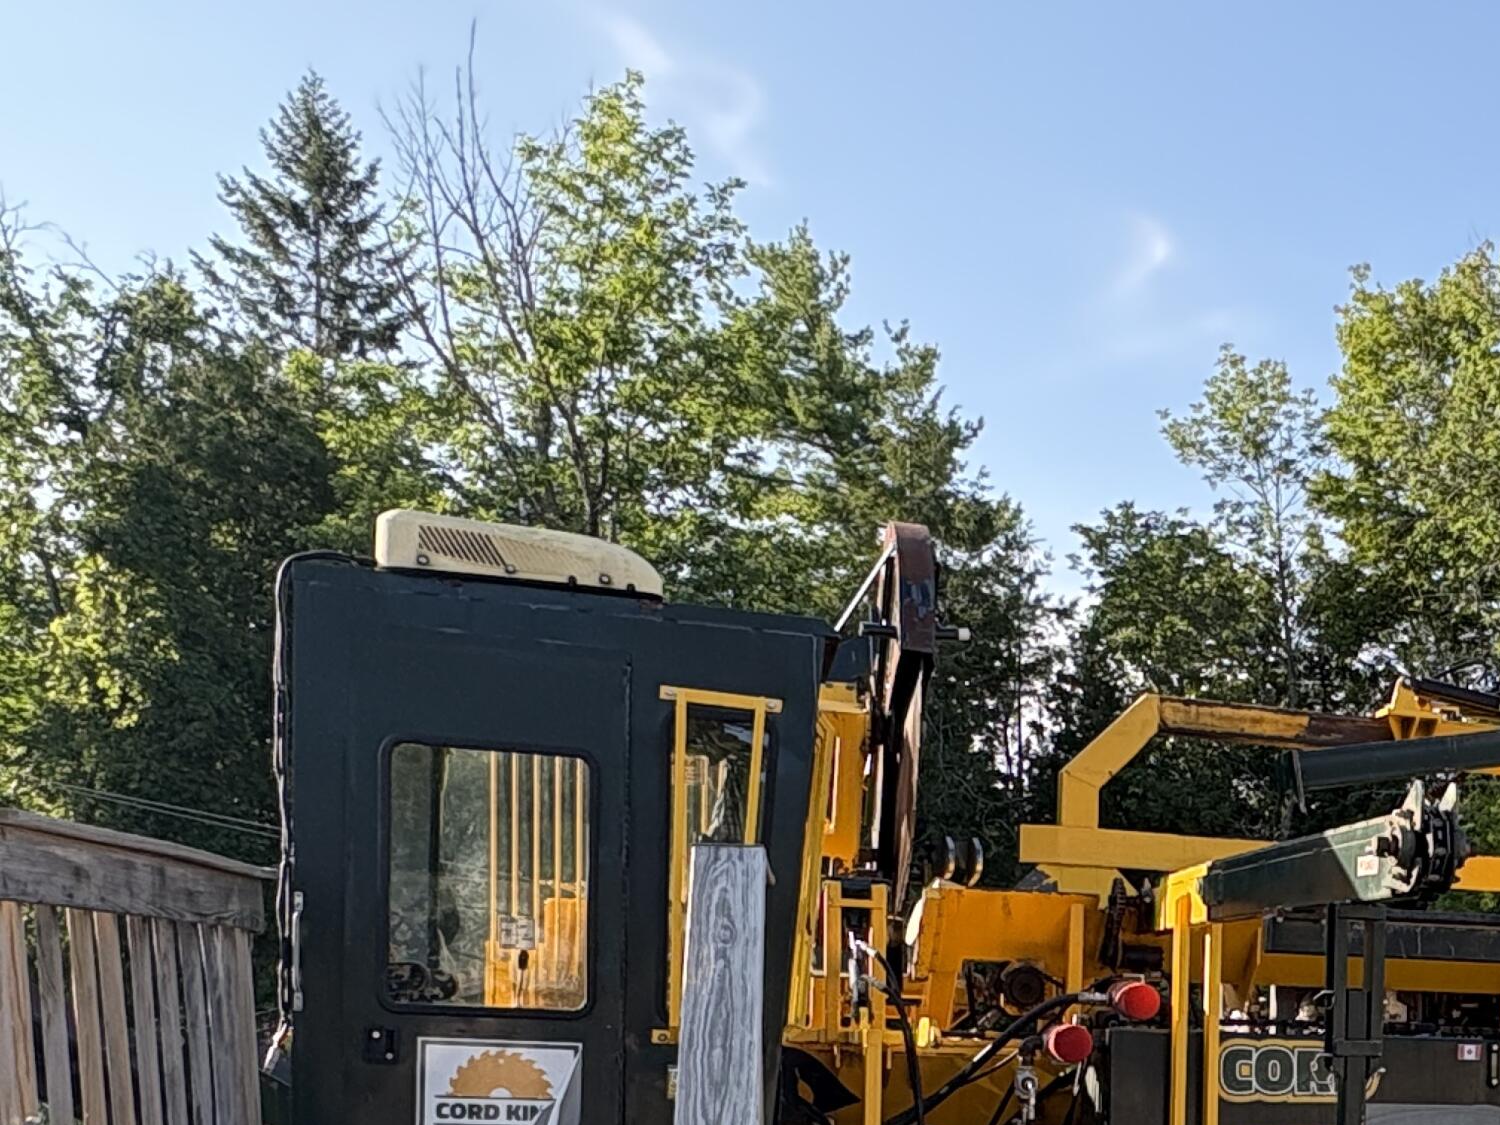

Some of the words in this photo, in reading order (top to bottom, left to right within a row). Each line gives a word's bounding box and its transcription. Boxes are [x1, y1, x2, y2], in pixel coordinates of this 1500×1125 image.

[1220, 1045, 1339, 1096] COR
[436, 1103, 500, 1120] CORD
[506, 1104, 543, 1121] KIN
